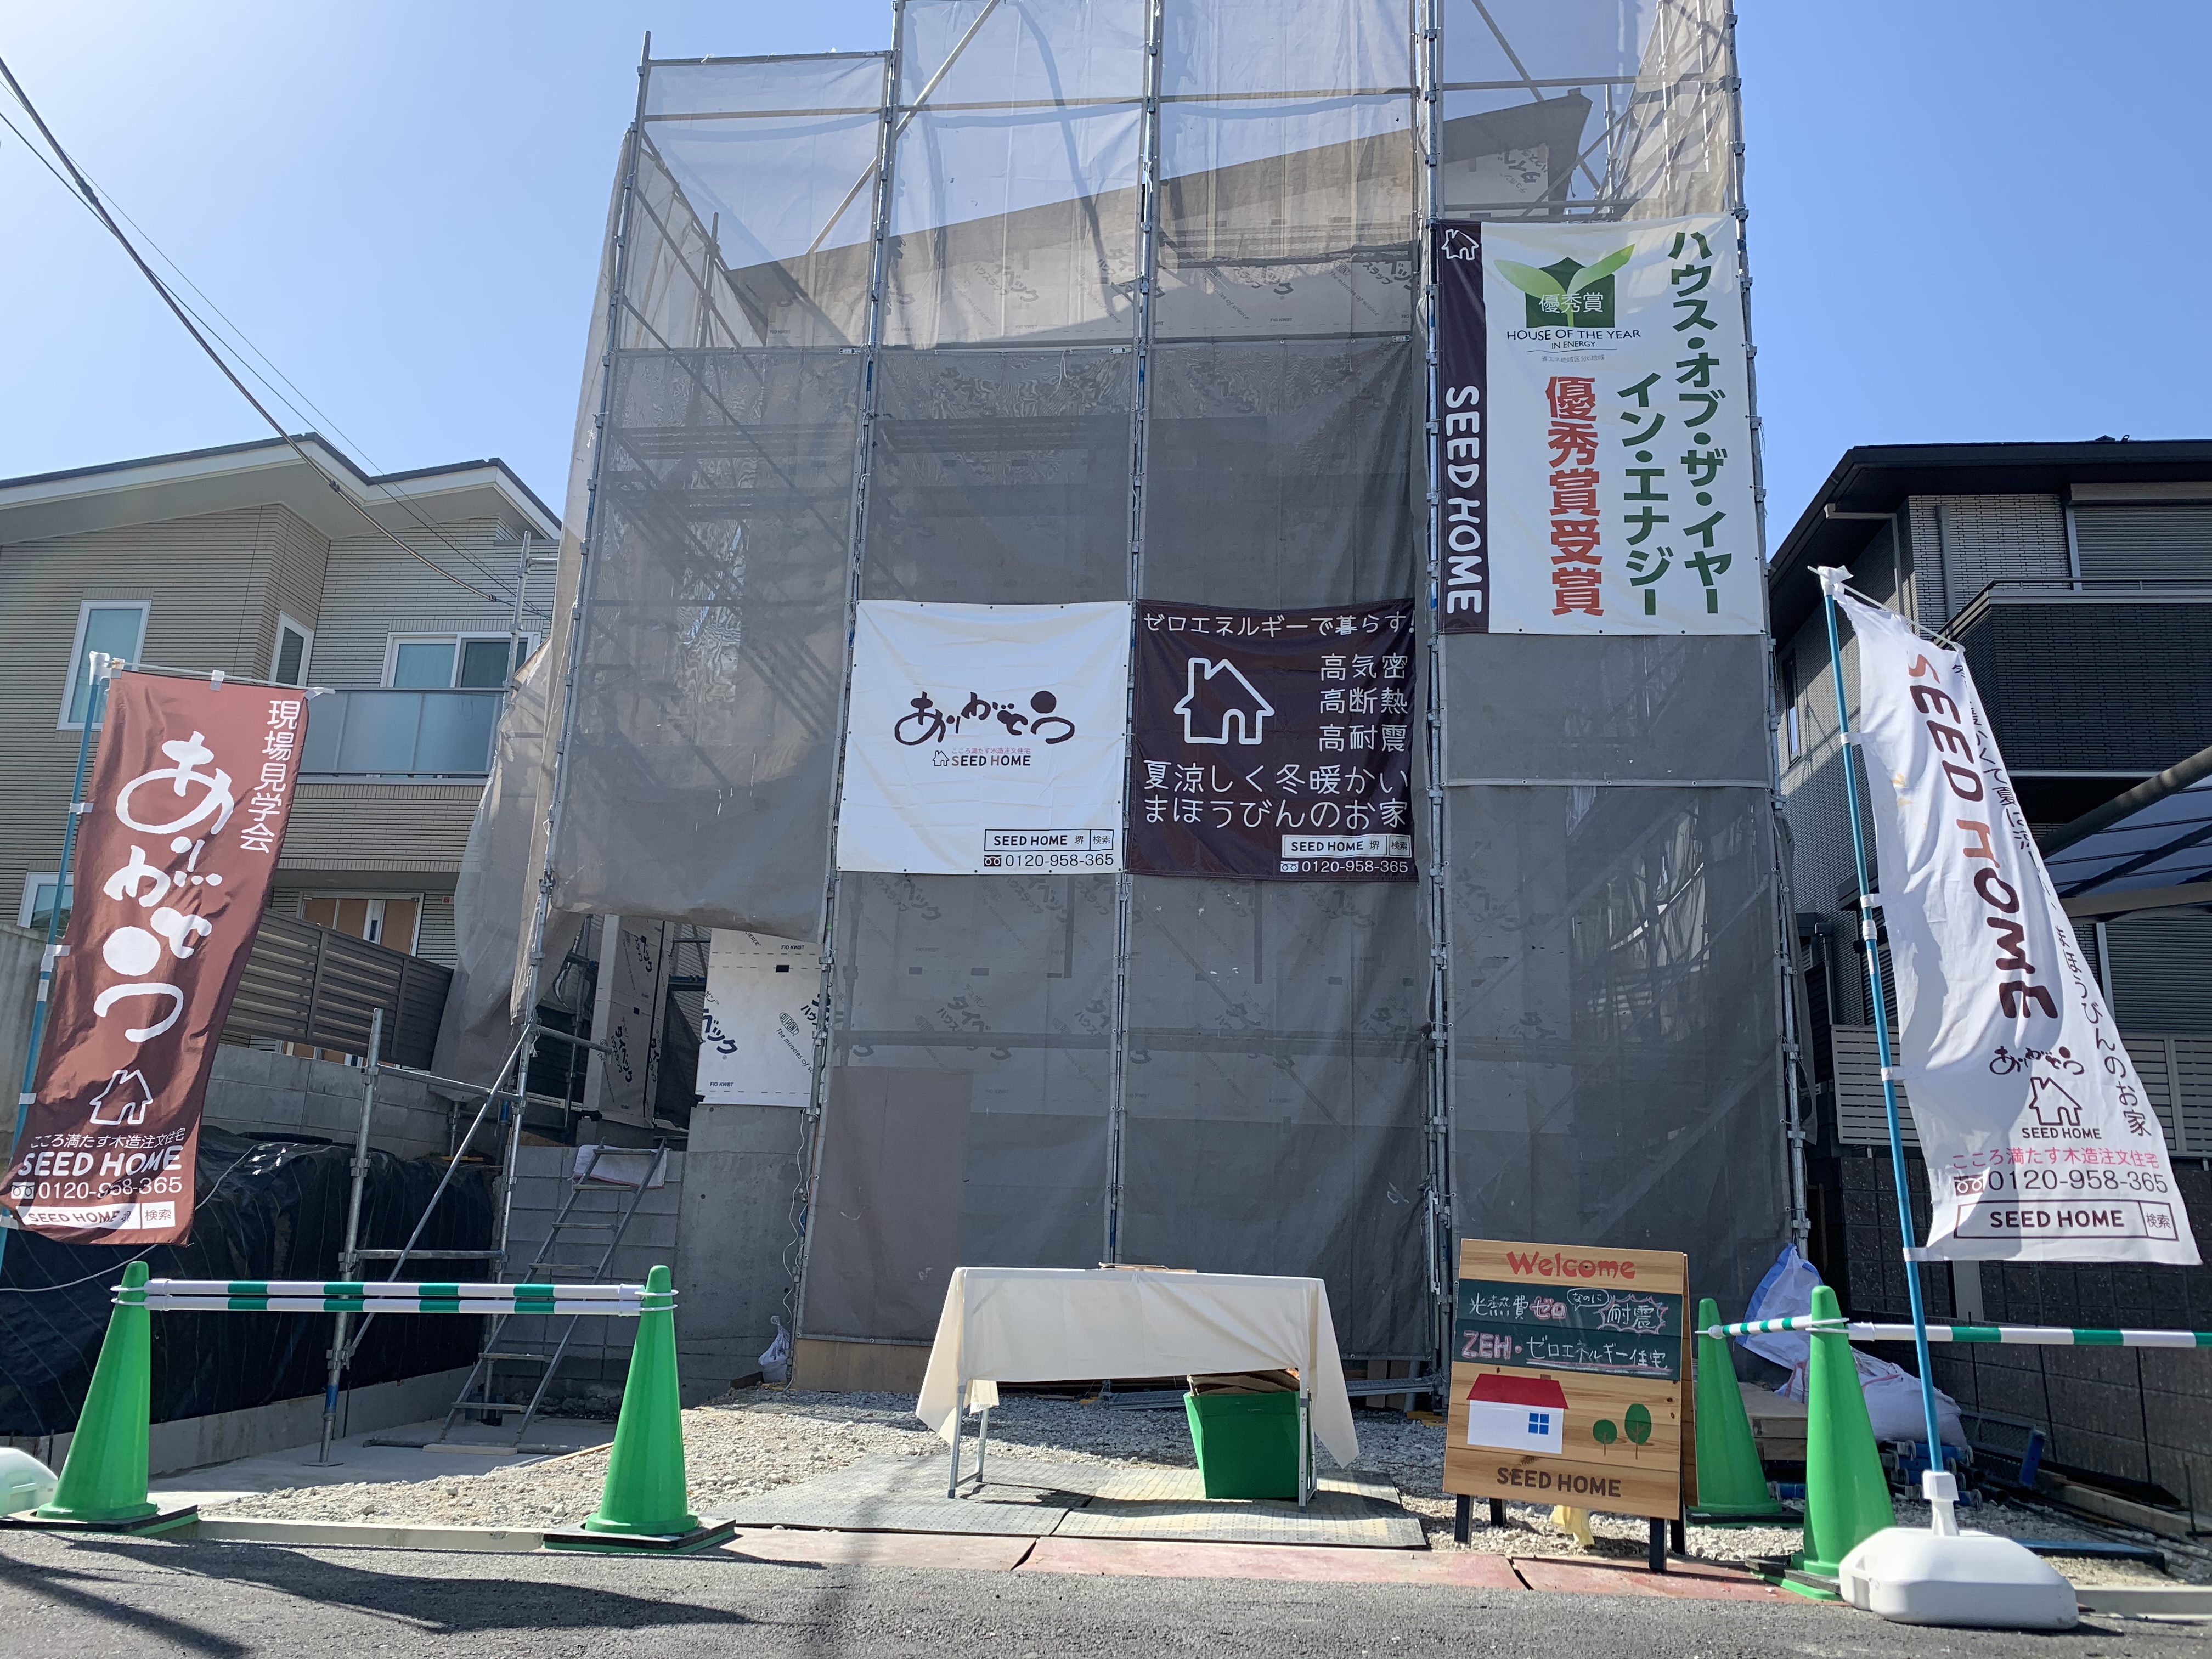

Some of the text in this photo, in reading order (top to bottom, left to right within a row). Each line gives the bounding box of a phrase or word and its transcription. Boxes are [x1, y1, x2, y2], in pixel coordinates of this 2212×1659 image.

[1538, 292, 1604, 313] 優秀賞
[1507, 329, 1641, 341] HOUSE OF THE YEAR
[1667, 232, 1732, 614] ハウス・オブ・ザ・イヤー
[1445, 385, 1482, 614] SEED HOME
[1544, 376, 1605, 617] 優秀賞受賞
[1617, 371, 1674, 616] イン・エナジー
[1321, 652, 1408, 681] 高気密
[1319, 686, 1408, 714] 高断熱
[1319, 724, 1405, 753] 高耐震
[951, 755, 1031, 766] SEED HOME
[240, 700, 301, 854] 現場見学会
[1144, 794, 1408, 831] まほうびんのお家
[994, 835, 1084, 846] SEED HOME 堺
[1092, 835, 1111, 845] 検索
[1291, 840, 1380, 851] SEED HOME 堺
[1391, 840, 1408, 851] 検索
[1907, 653, 2058, 1019] SEED HOME
[1006, 854, 1114, 867] 0120-958-365
[1302, 860, 1408, 873] 0120-958-365
[776, 1028, 810, 1067] The miracles of
[30, 1127, 185, 1149] こころ満たす木造注文住宅
[2021, 1127, 2102, 1139] SEED HOME
[18, 1145, 184, 1177] SEED HOME
[1953, 1147, 2160, 1169] こころ満たす木造注文住宅
[38, 1176, 182, 1200] 0120-958-365
[1988, 1170, 2168, 1193] 0120-958-365
[28, 1212, 70, 1223] SEED
[72, 1210, 120, 1224] HOME
[144, 1209, 172, 1222] 検索
[1990, 1210, 2125, 1228] SEED HOME
[2146, 1212, 2172, 1229] 検索
[1506, 1251, 1636, 1279] Welcome
[1572, 1293, 1602, 1303] なのに
[1607, 1304, 1656, 1329] 耐震
[1497, 1467, 1621, 1498] SEED HOME
